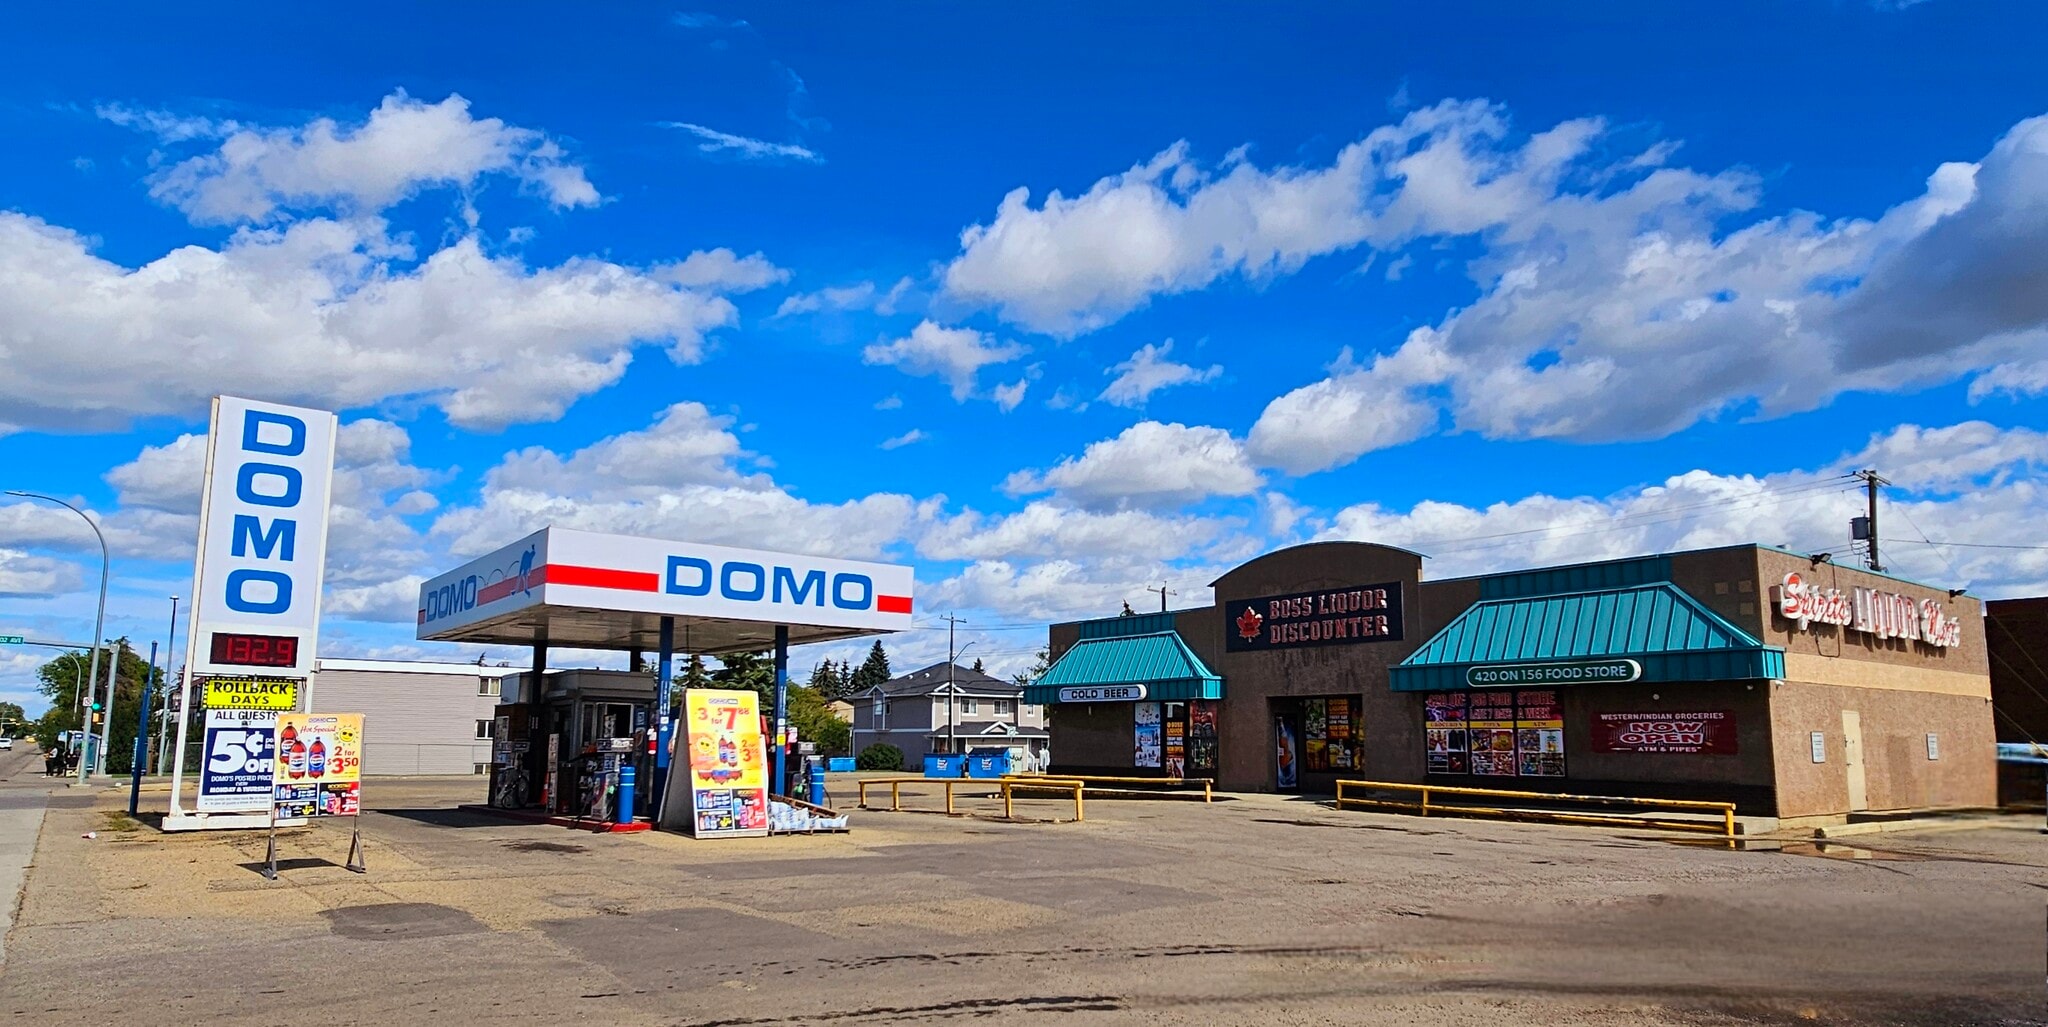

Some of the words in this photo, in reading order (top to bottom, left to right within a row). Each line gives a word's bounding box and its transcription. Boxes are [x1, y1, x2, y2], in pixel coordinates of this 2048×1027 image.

[225, 409, 306, 615] DOMO
[666, 555, 873, 611] DOMO
[427, 574, 477, 622] DOMO
[1269, 596, 1312, 620] BOSS
[1318, 588, 1388, 615] LIQUOR
[1780, 571, 1852, 631] Spirits
[1852, 585, 1921, 640] LIQUOR
[1270, 614, 1389, 644] DISCOUNTER
[226, 637, 294, 663] 132.9
[1475, 671, 1498, 682] 420
[1500, 670, 1519, 681] ON
[1521, 669, 1543, 680] 156
[1545, 667, 1582, 679] FOOD
[1585, 665, 1627, 678] STORE
[213, 681, 289, 695] ROLLBACK
[1071, 689, 1098, 699] COLD
[1104, 688, 1129, 698] BEER
[231, 695, 270, 705] DAYS
[1517, 691, 1556, 705] STORE
[215, 711, 235, 720] ALL
[238, 711, 278, 720] GUESTS
[697, 707, 708, 720] 3
[1518, 708, 1524, 719] A
[1525, 707, 1551, 719] WEEK
[1674, 712, 1725, 720] GROCERIES
[313, 725, 337, 733] Special
[1629, 721, 1704, 733] NOW
[1620, 732, 1704, 744] OPEN
[334, 746, 343, 756] 2
